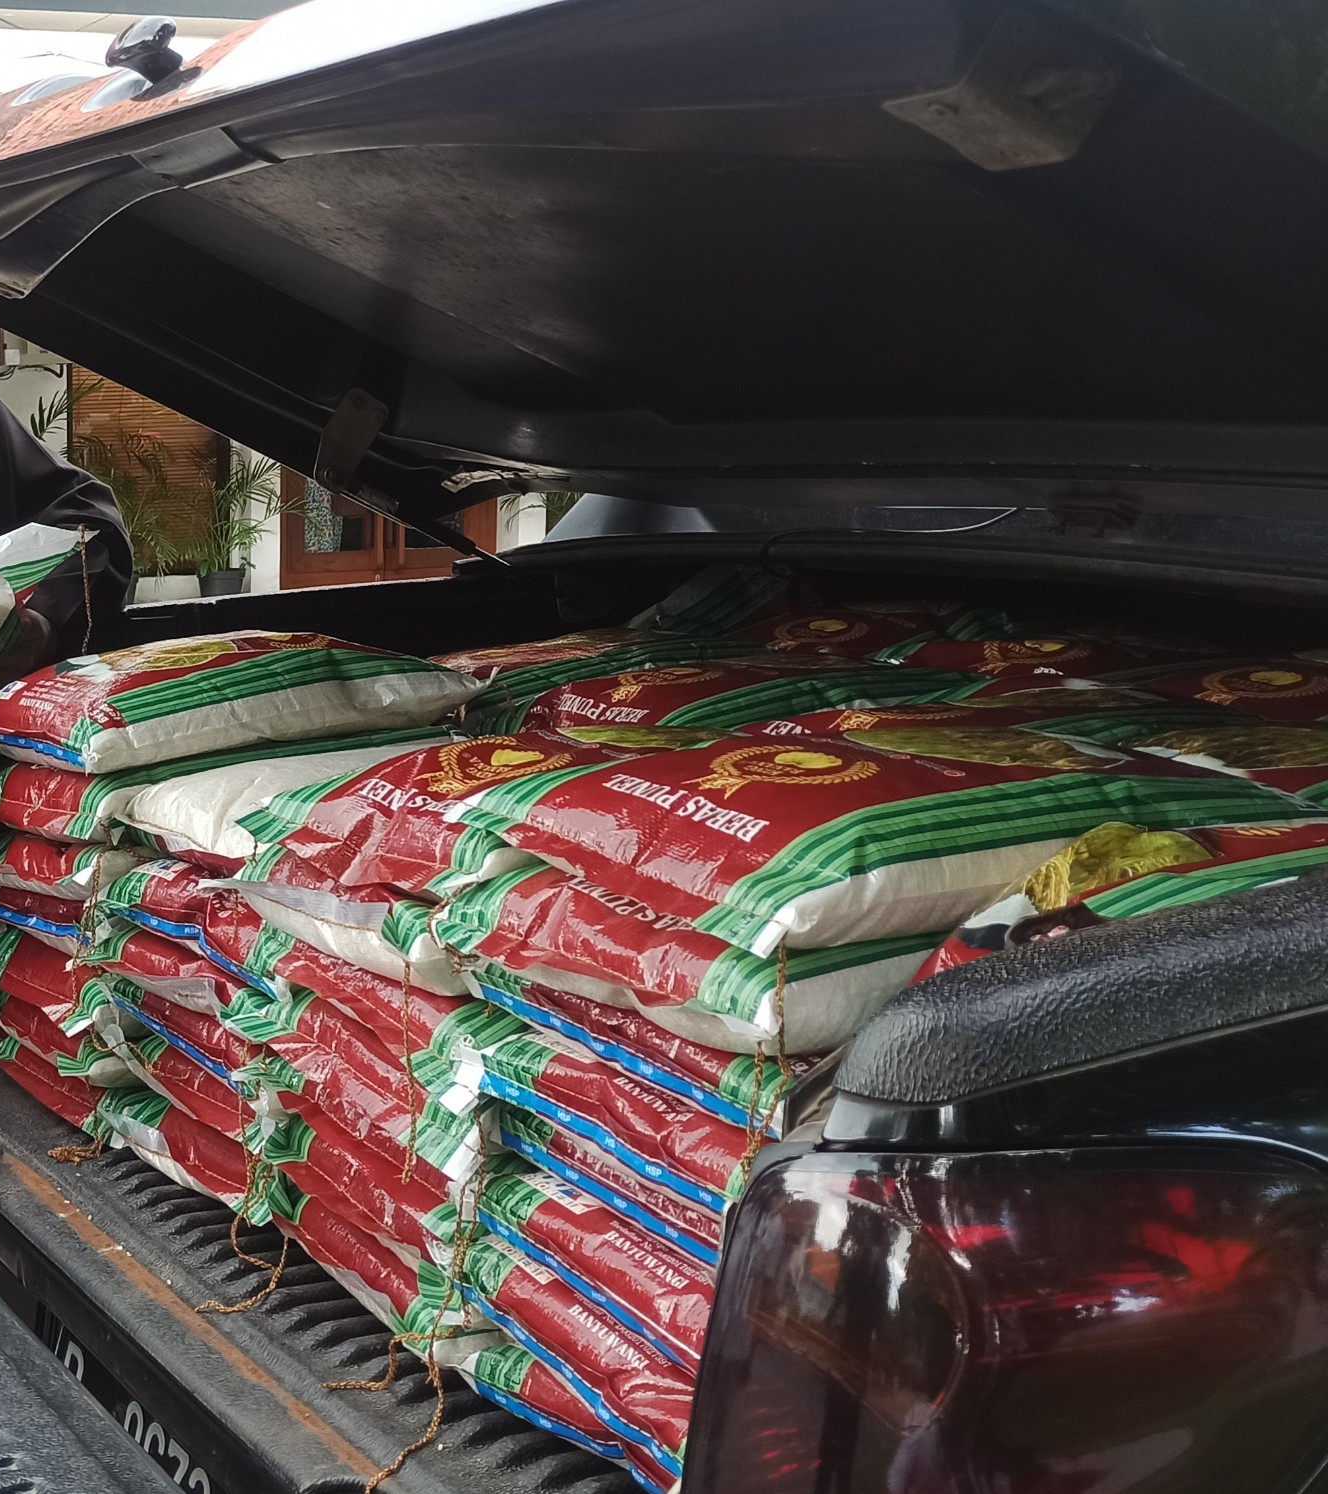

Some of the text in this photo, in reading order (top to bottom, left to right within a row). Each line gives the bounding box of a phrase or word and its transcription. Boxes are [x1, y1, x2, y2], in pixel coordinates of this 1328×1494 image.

[557, 693, 607, 720] PUNEL
[601, 706, 650, 723] BERAS
[602, 773, 770, 843] BERAS PUNEL
[644, 1164, 663, 1177] HSP
[604, 1230, 690, 1290] BANYUWANGI
[568, 1303, 651, 1371] BANYUWANGI
